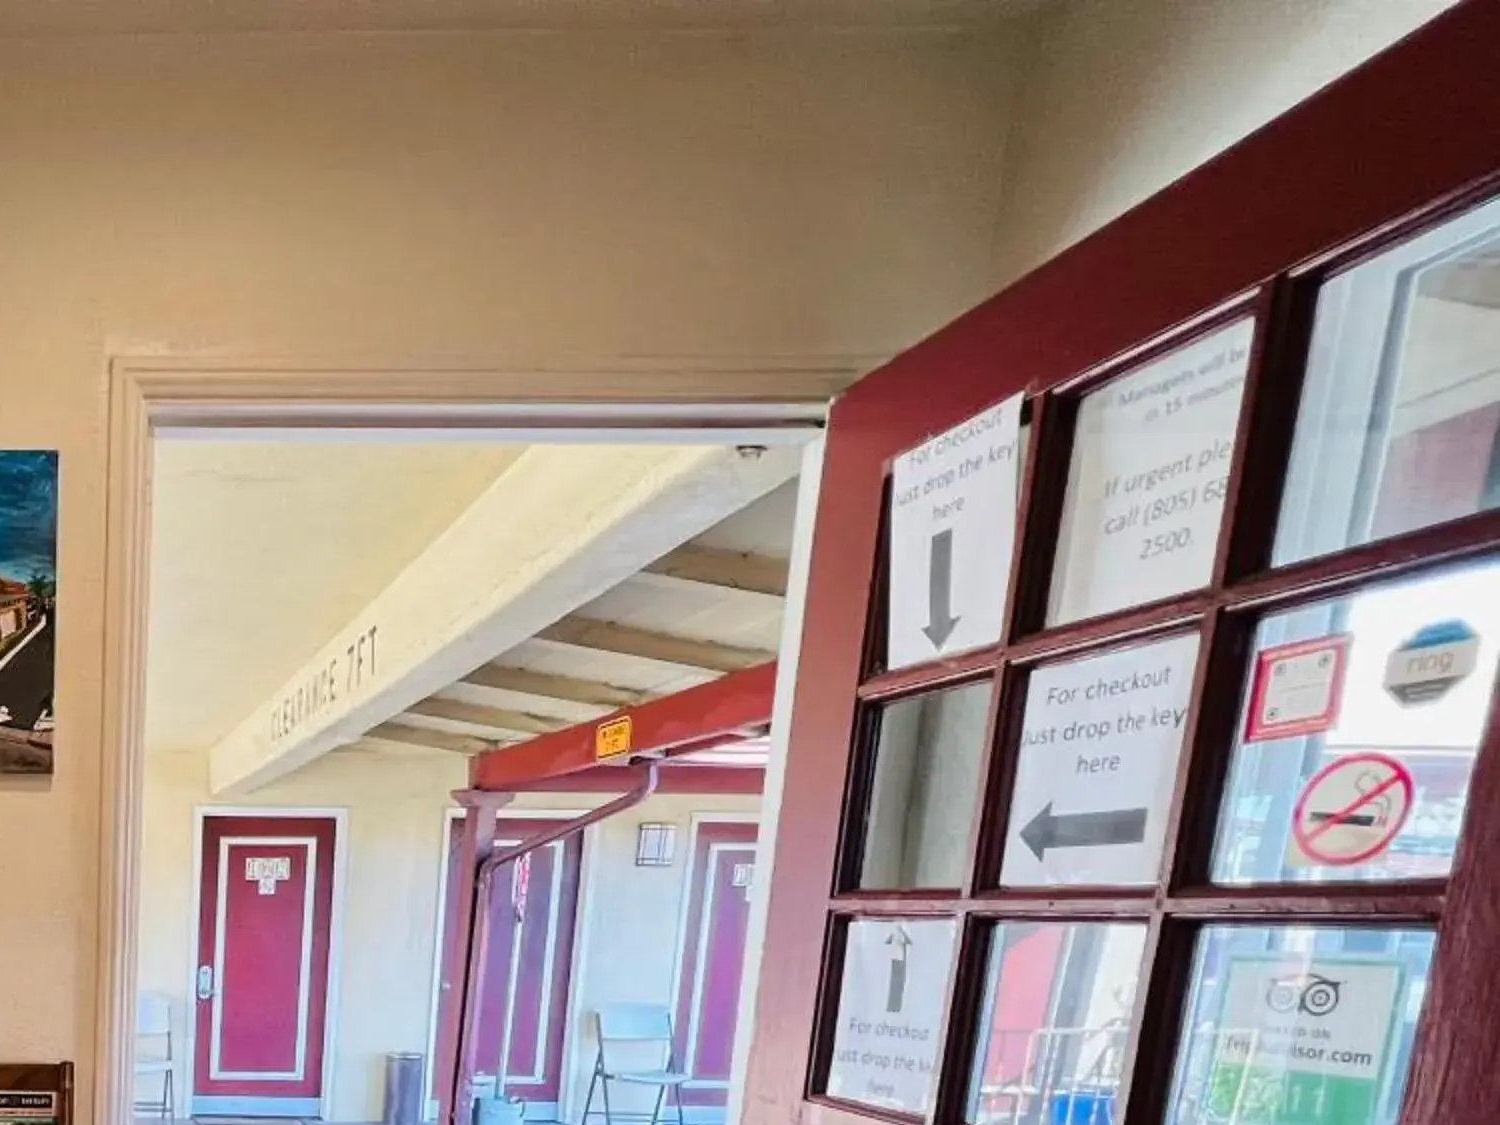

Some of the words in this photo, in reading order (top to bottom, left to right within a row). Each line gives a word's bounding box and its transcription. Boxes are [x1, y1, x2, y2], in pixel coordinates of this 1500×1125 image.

[959, 453, 984, 478] the
[1124, 453, 1193, 494] urgent
[933, 496, 966, 520] here
[1103, 503, 1140, 536] call
[1143, 486, 1197, 528] (805)
[1406, 651, 1455, 673] ring
[1047, 686, 1080, 706] For
[1085, 665, 1172, 700] checkout
[1063, 720, 1111, 741] drop
[1117, 710, 1147, 734] the
[1150, 706, 1187, 730] key
[1075, 753, 1122, 774] here
